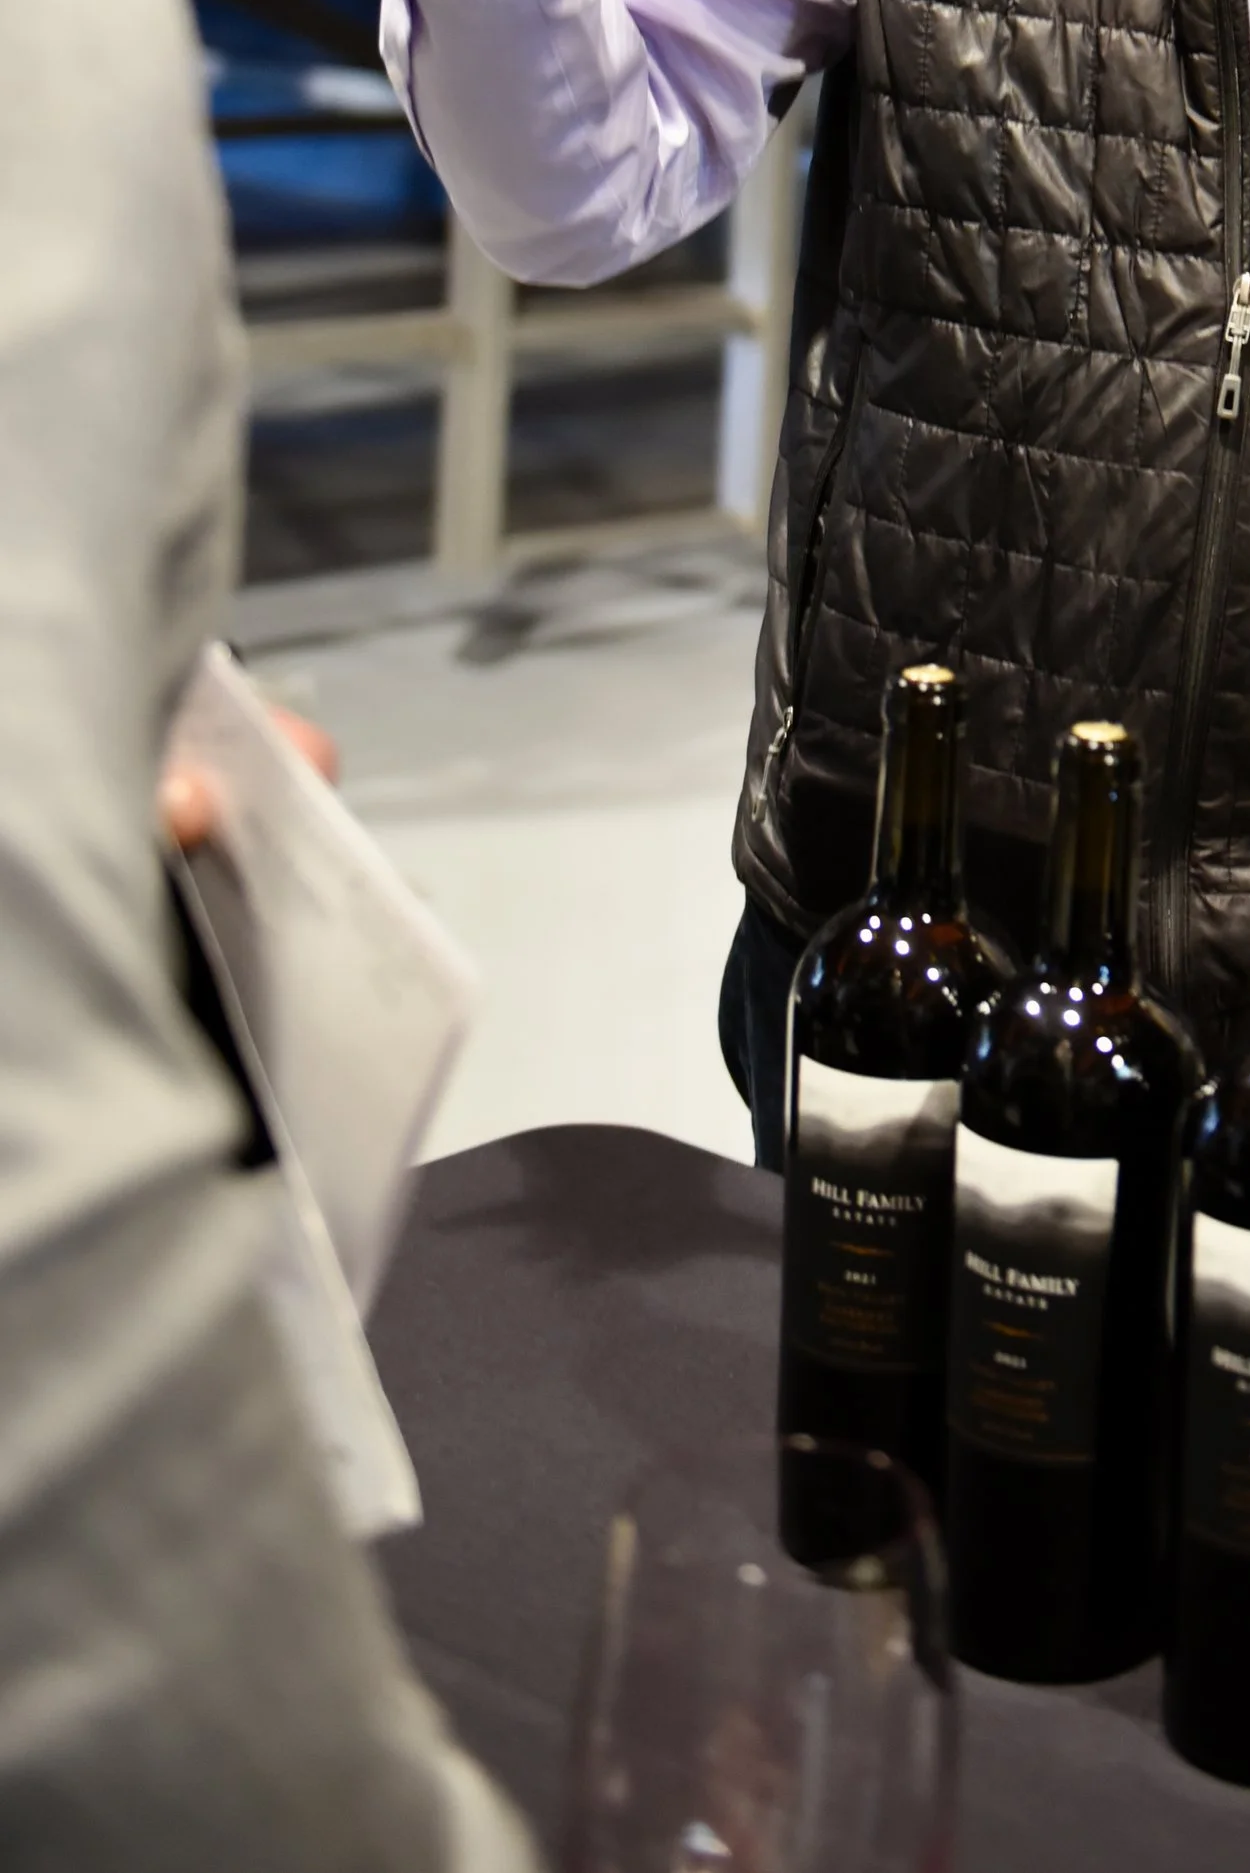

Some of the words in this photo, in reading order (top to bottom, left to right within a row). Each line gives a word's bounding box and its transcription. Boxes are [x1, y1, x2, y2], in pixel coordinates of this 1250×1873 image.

[811, 1176, 851, 1206] HILL
[855, 1188, 927, 1213] FAMILY
[963, 1249, 1003, 1283] HILL
[1005, 1266, 1079, 1297] FAMILY
